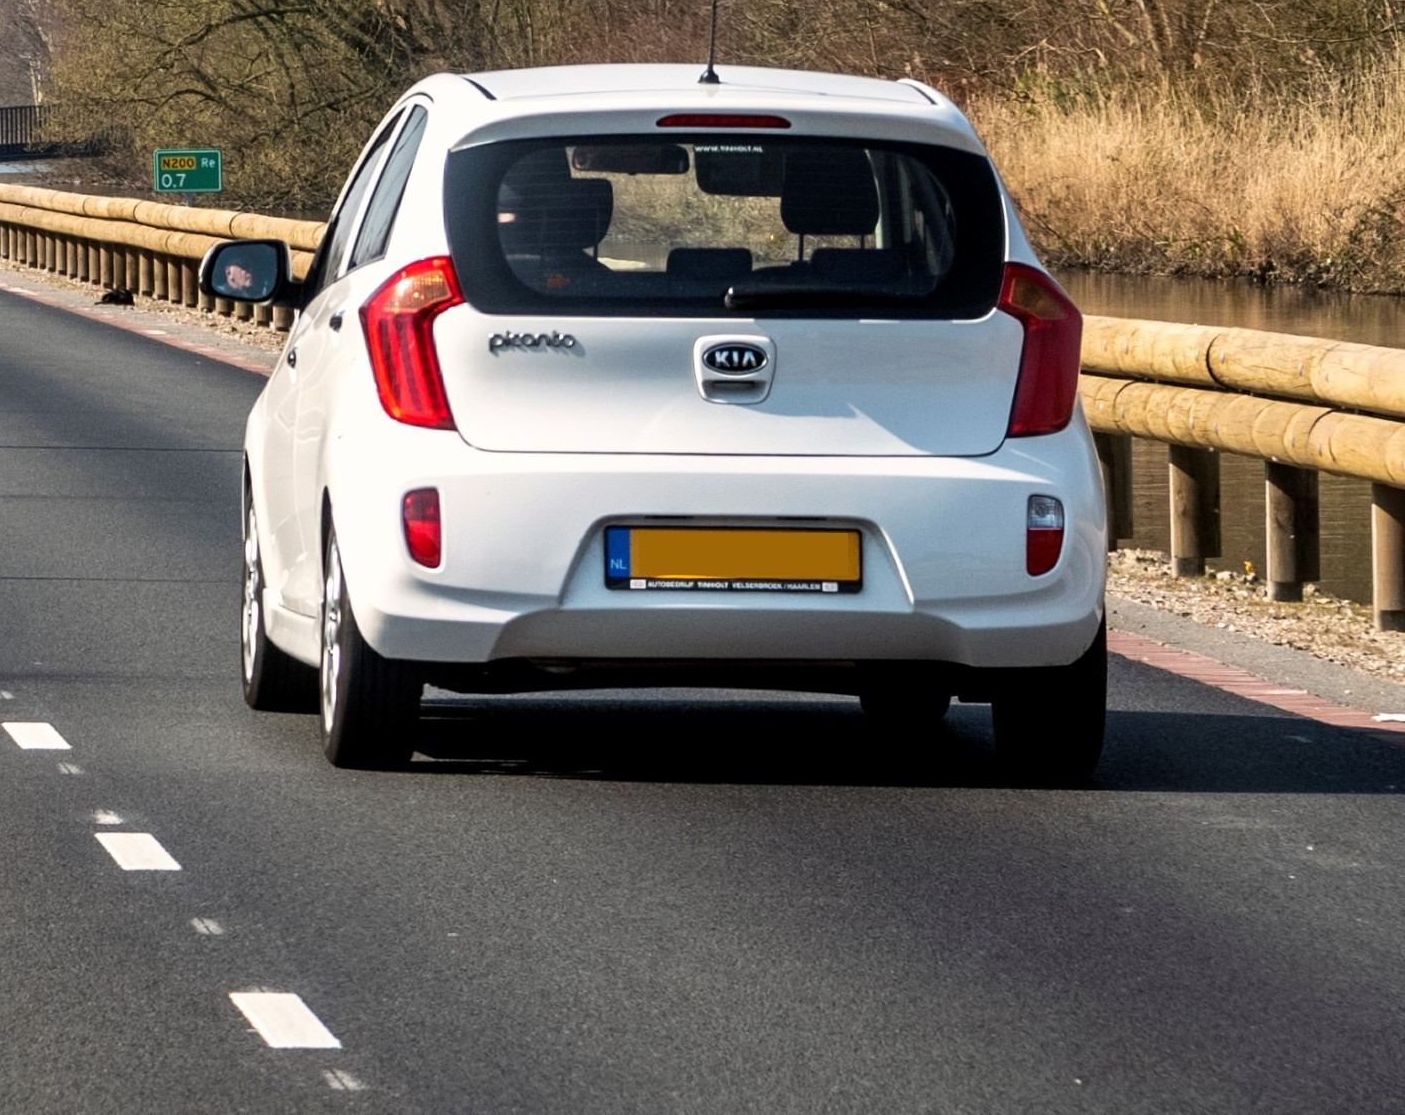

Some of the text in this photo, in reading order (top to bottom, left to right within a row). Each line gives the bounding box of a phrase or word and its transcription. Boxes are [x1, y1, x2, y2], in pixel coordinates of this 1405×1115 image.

[162, 157, 216, 169] N200 Re
[161, 173, 186, 188] 0.7
[715, 350, 757, 368] KIA
[610, 558, 628, 570] NL
[647, 580, 695, 588] AUTOBEDRIJF
